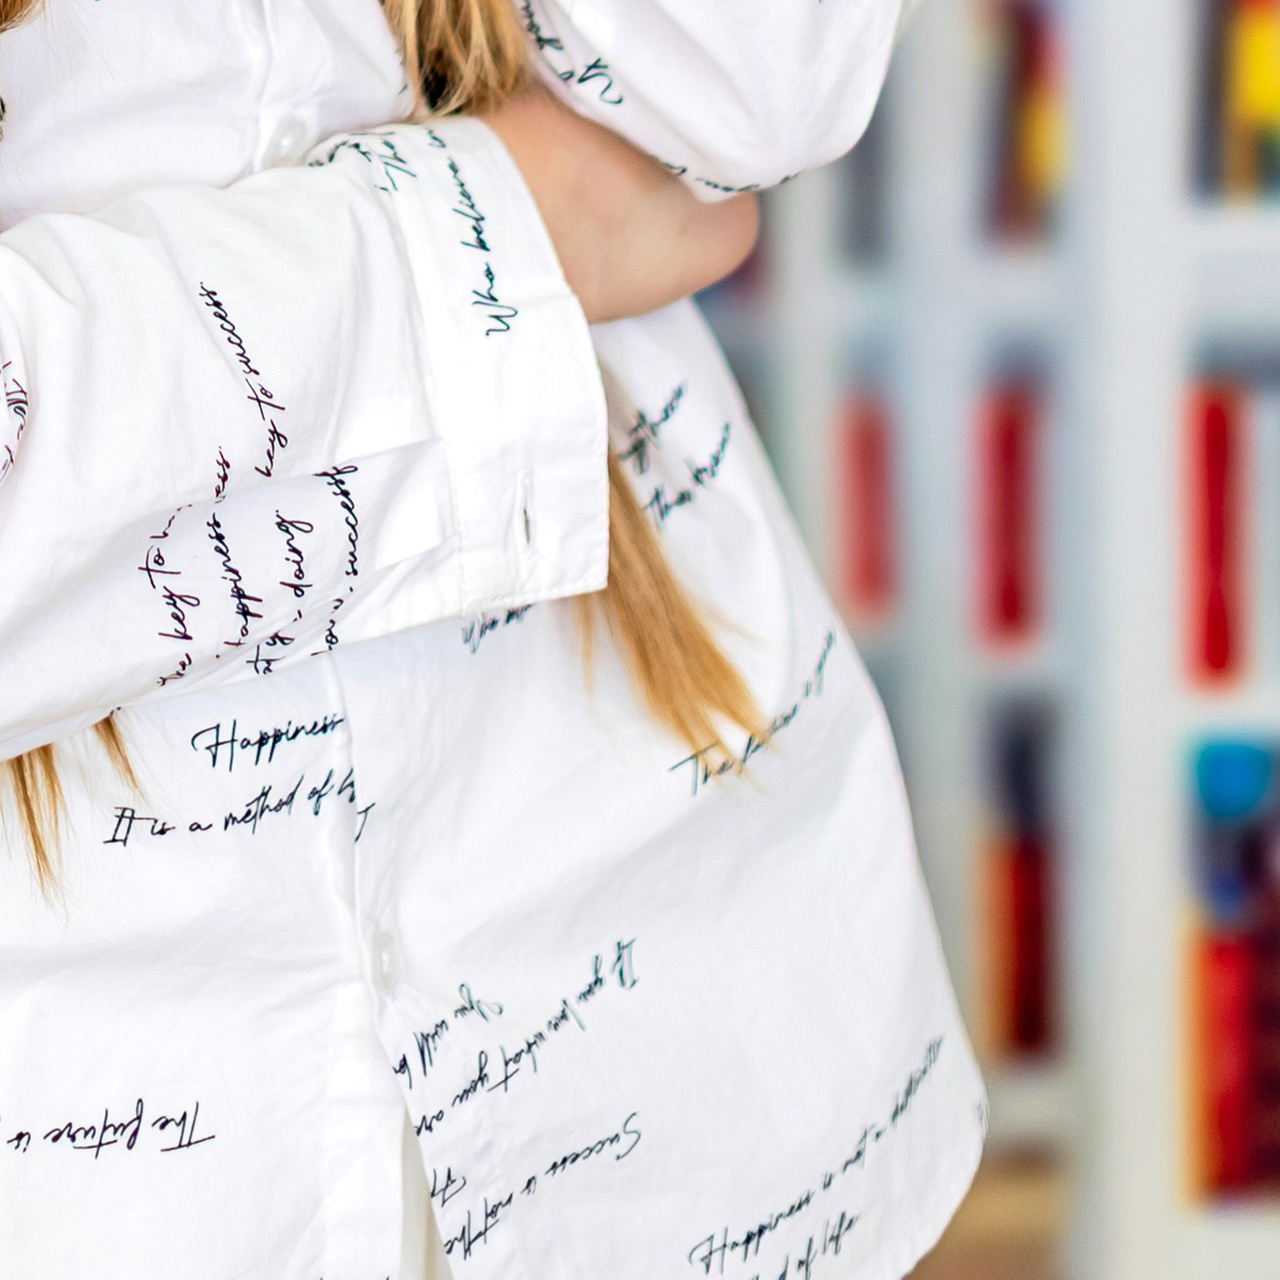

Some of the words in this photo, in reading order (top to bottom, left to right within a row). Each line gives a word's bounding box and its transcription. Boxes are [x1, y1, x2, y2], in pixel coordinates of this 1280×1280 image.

[471, 261, 519, 337] Who
[245, 376, 287, 420] to
[312, 462, 362, 579] successf
[138, 543, 183, 590] to
[157, 584, 201, 643] key
[223, 774, 306, 835] method
[6, 1132, 31, 1154] is
[42, 1097, 145, 1159] future
[150, 1101, 216, 1153] The
[544, 1112, 642, 1177] Success
